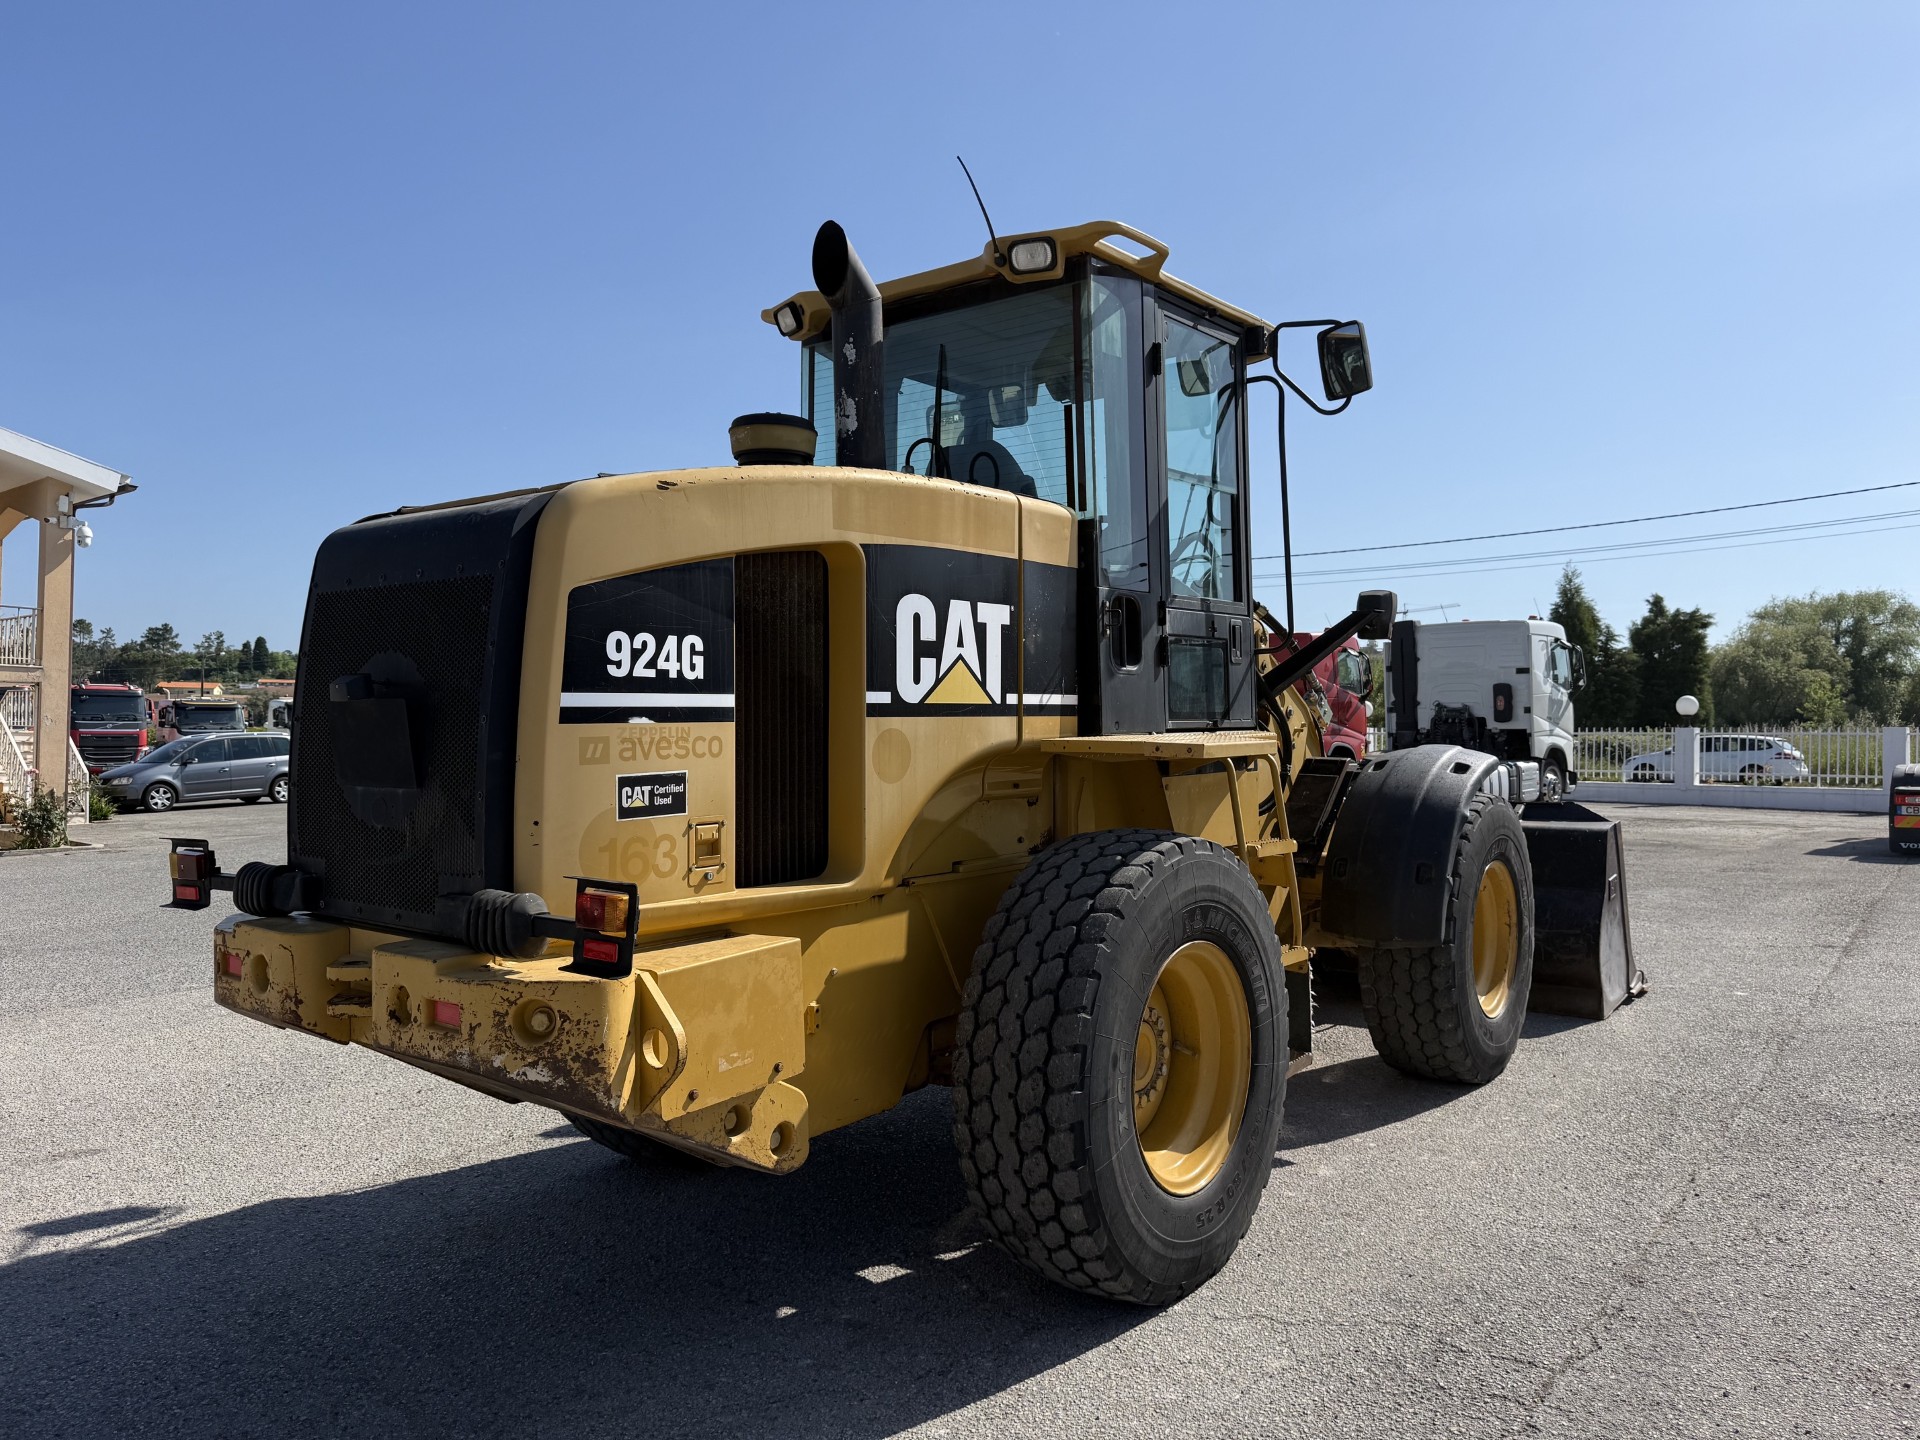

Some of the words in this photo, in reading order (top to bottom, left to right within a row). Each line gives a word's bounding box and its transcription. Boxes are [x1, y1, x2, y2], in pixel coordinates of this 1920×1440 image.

[606, 631, 704, 680] 924G
[896, 593, 1010, 704] CAT
[617, 727, 691, 739] ZEPPELIN
[618, 735, 723, 762] avesco
[621, 786, 652, 808] CAT
[654, 783, 684, 795] Certified
[654, 795, 672, 806] Used
[598, 833, 679, 881] 163
[1205, 908, 1268, 1008] MICHELIN
[1196, 1207, 1214, 1230] 25
